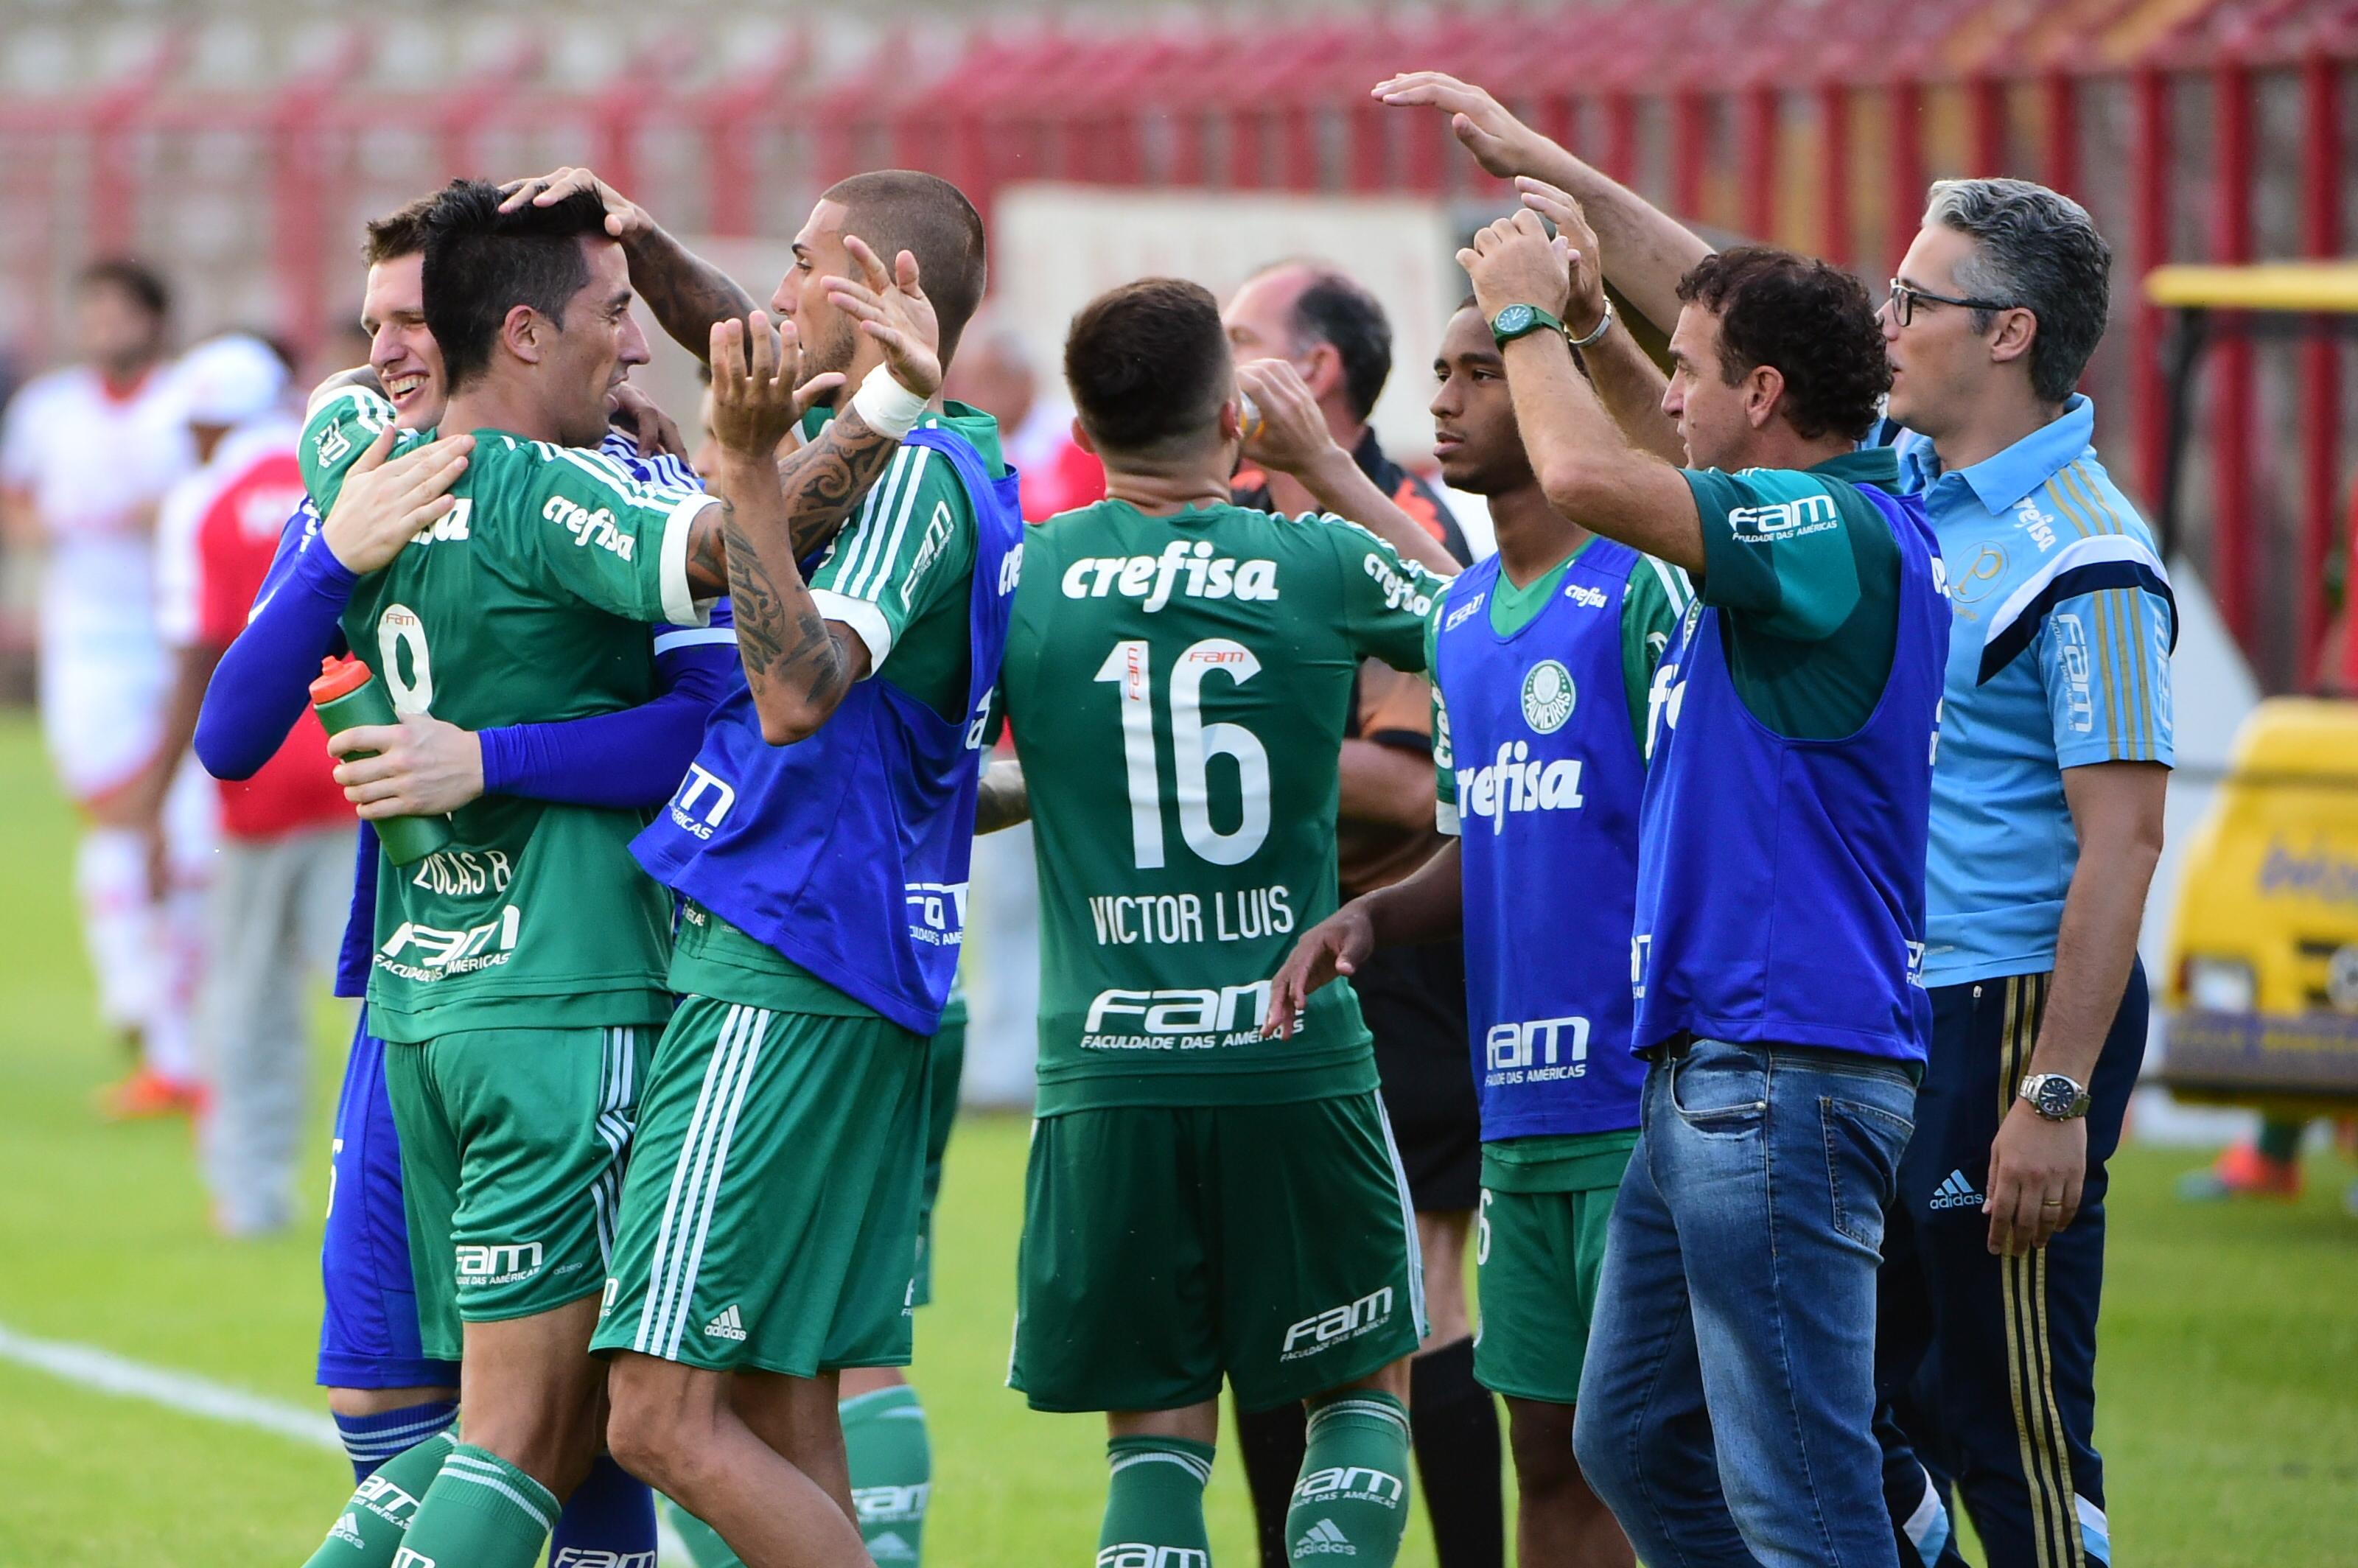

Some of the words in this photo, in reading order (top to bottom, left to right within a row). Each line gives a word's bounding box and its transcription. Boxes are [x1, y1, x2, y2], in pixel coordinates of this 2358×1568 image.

[542, 495, 635, 562] crefisa
[1777, 530, 1794, 540] DAS
[2012, 496, 2057, 553] refisa
[1061, 541, 1280, 613] crefisa
[1564, 584, 1609, 609] crefisa
[1524, 691, 1571, 729] PALMEIRAS
[1094, 638, 1271, 869] 16
[1456, 740, 1584, 836] refisa
[1088, 893, 1203, 945] VICTOR
[1215, 885, 1295, 941] LUIS
[1080, 1035, 1175, 1050] FACULDADE
[1180, 1035, 1216, 1049] DAS
[1526, 1063, 1586, 1083] AMÉRICAS
[1929, 1193, 1984, 1210] adidas
[470, 1275, 487, 1286] DAS
[704, 1324, 747, 1342] adidas
[1315, 1491, 1339, 1502] DAS
[1292, 1540, 1357, 1559] adidas
